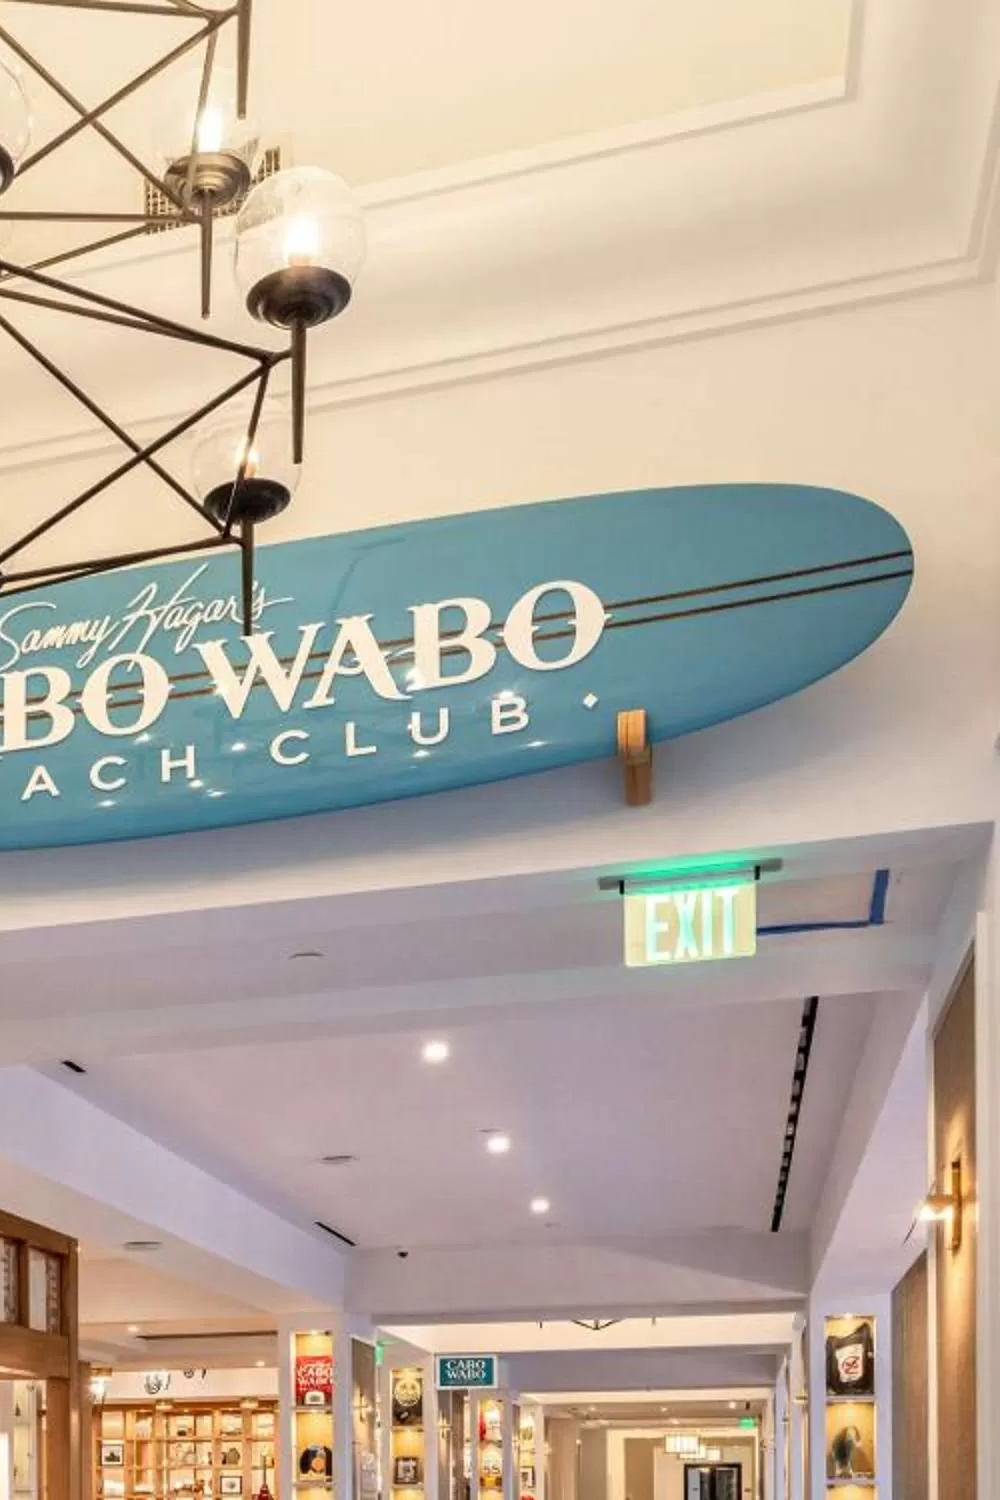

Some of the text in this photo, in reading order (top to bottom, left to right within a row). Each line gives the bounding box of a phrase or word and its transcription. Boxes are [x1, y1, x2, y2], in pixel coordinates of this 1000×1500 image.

[86, 564, 295, 673] Hagar's
[192, 579, 614, 721] WABO
[269, 694, 530, 767] CLUB
[645, 886, 741, 962] EXIT
[444, 1359, 487, 1370] CABO
[445, 1369, 487, 1381] WABO
